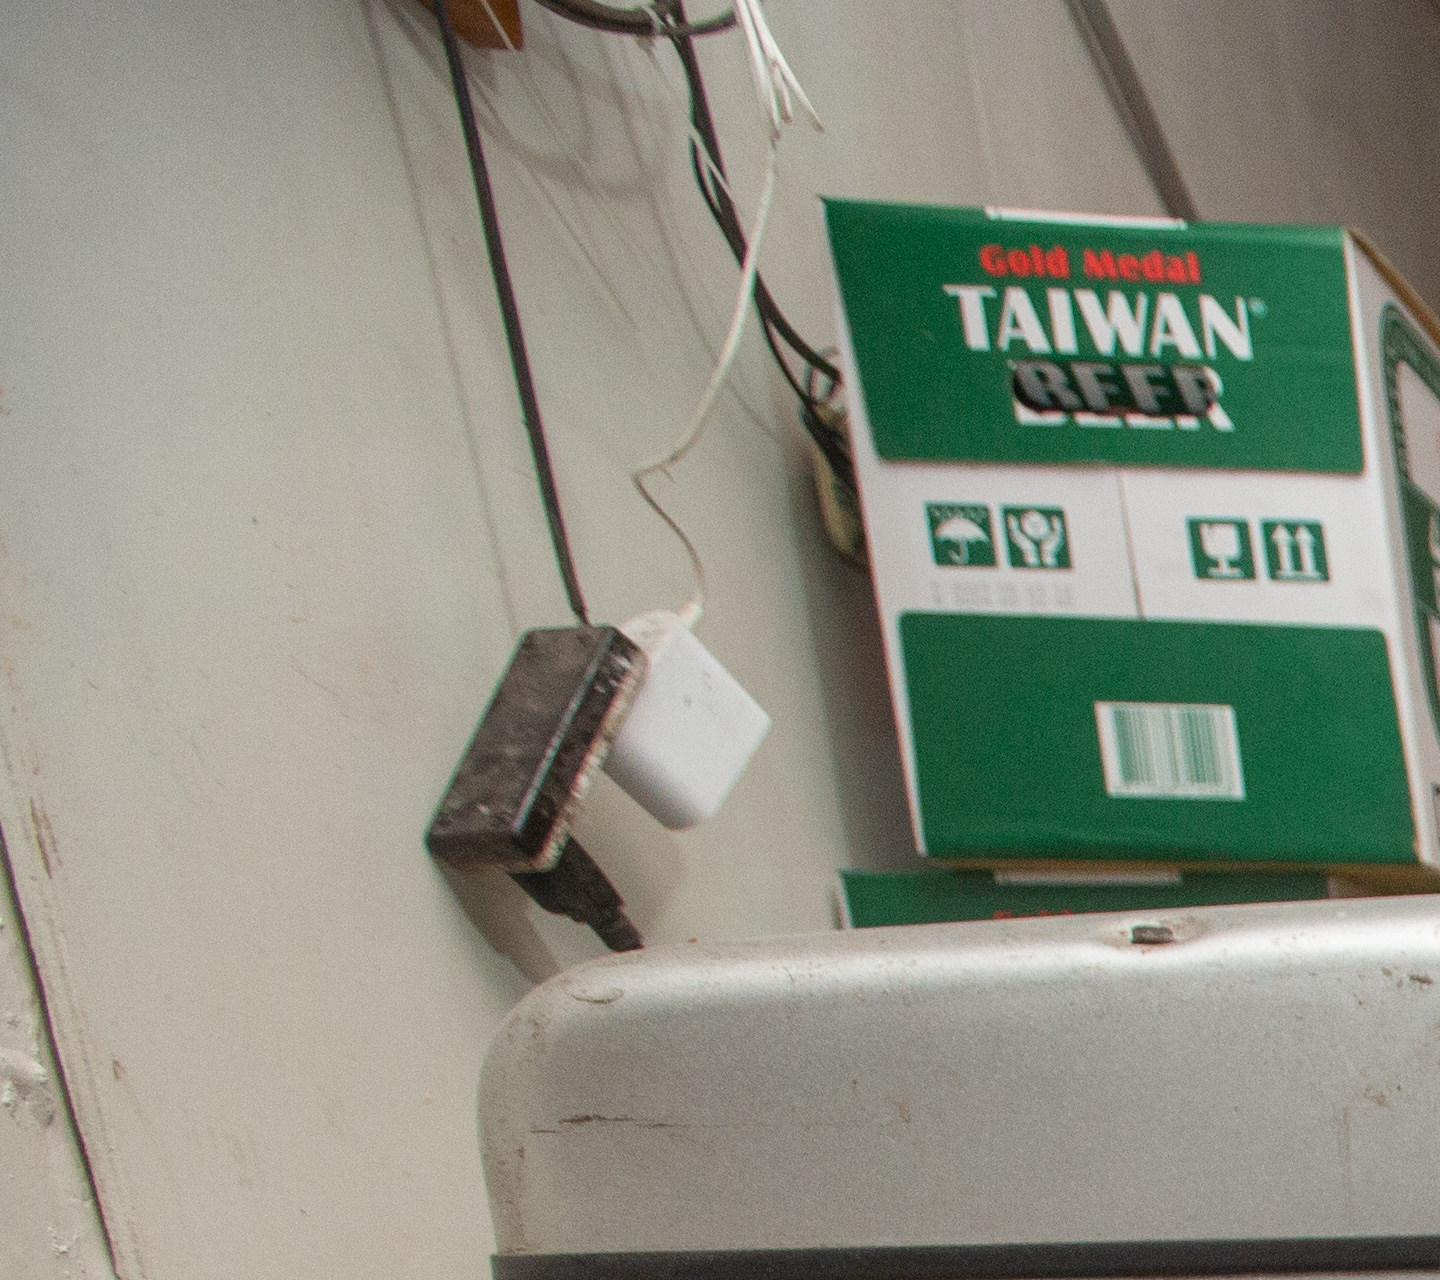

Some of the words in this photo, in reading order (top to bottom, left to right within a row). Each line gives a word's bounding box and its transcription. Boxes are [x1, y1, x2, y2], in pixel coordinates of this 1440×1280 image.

[979, 244, 1070, 280] Gold
[1082, 247, 1202, 285] Medal
[942, 282, 1255, 361] TAIWAN
